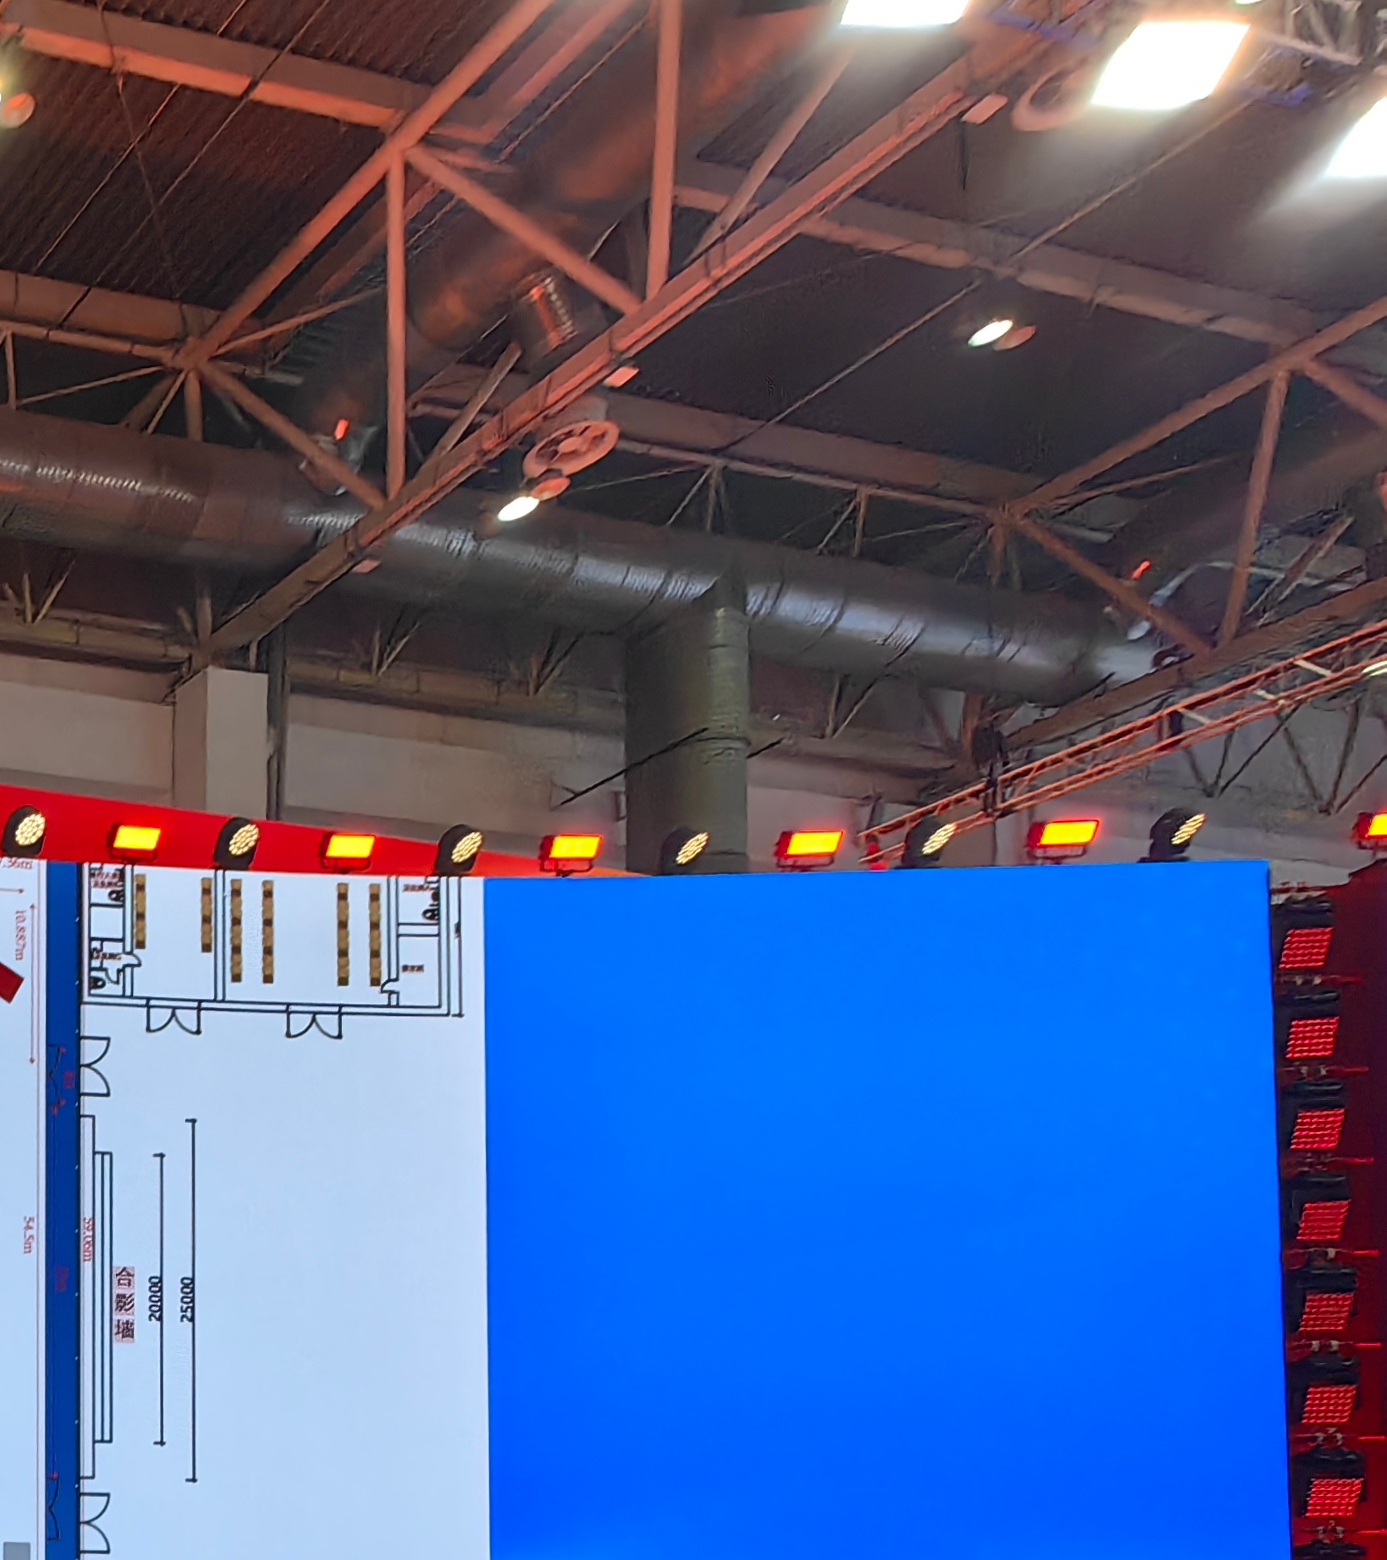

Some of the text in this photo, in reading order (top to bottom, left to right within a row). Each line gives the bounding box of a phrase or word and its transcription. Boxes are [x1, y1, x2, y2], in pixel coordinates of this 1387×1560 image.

[116, 1267, 135, 1340] 合影墙
[148, 1275, 163, 1322] 20000
[180, 1276, 195, 1323] 25000
